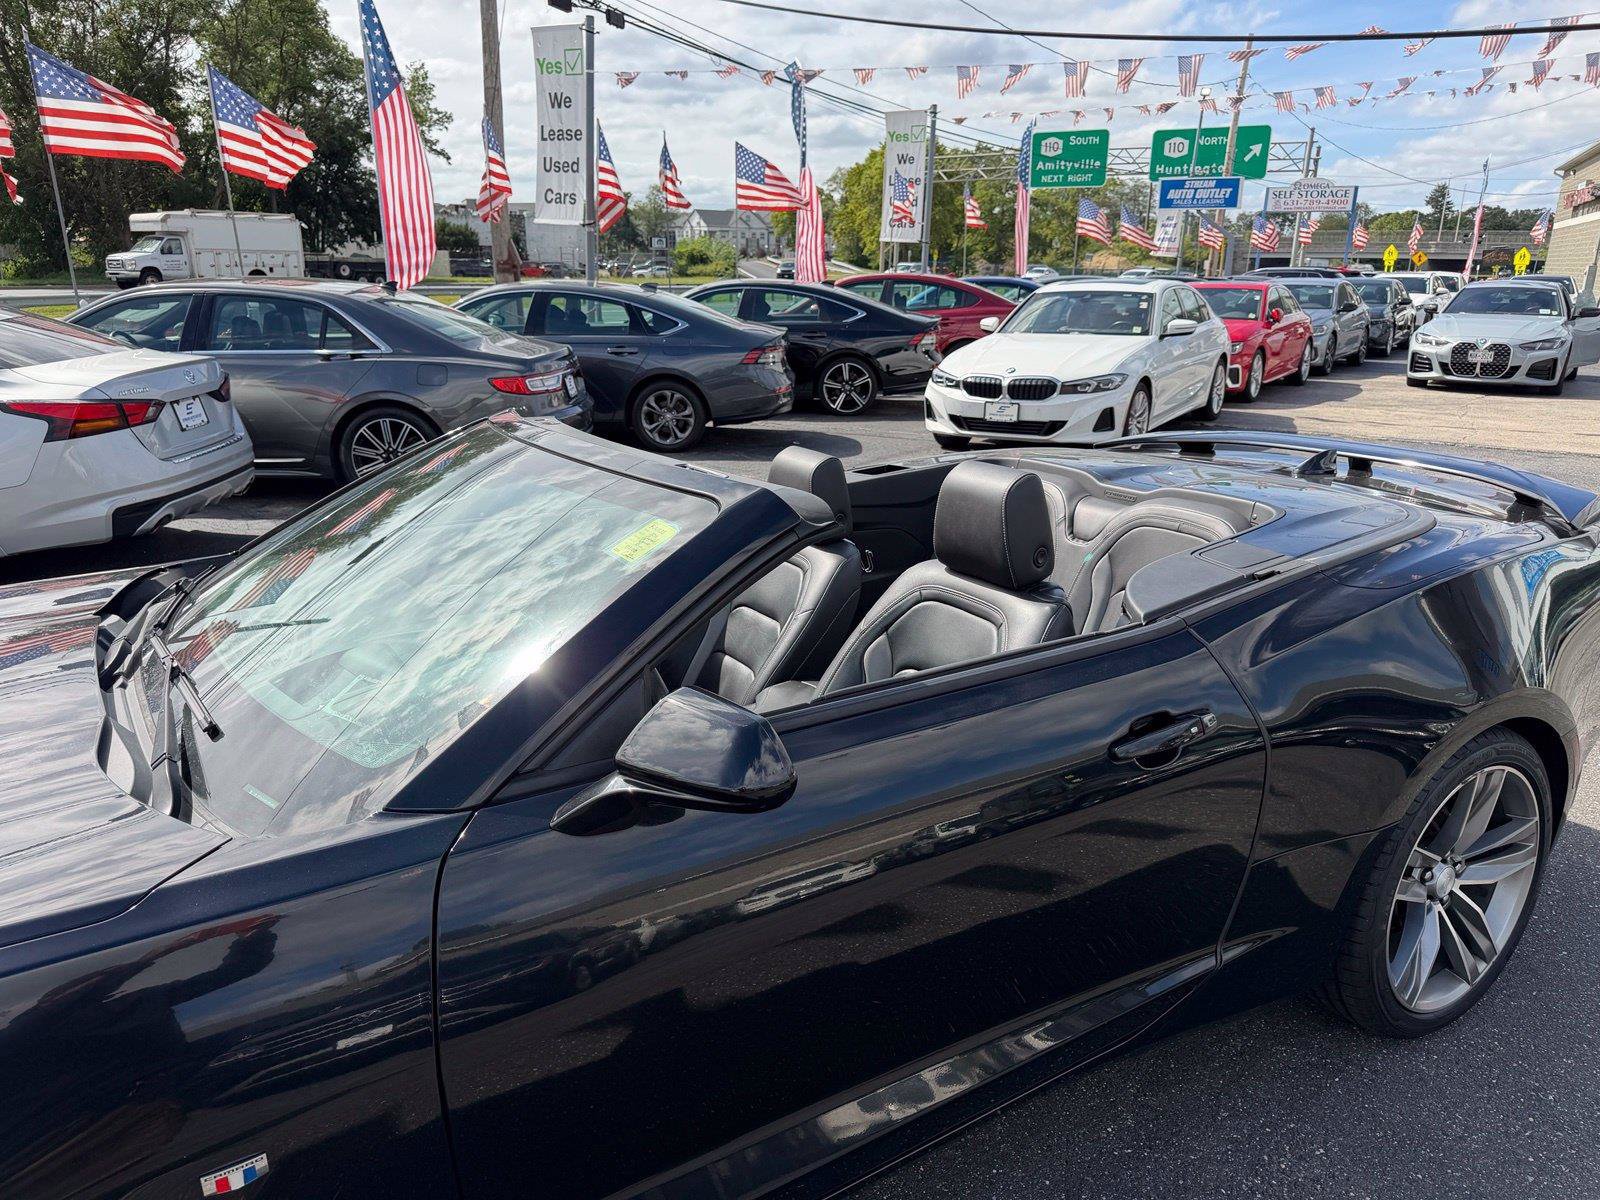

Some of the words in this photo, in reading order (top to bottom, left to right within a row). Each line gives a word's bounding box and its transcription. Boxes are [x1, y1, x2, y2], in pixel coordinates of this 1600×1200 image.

[536, 58, 563, 75] Yes
[548, 92, 573, 109] We
[540, 125, 583, 142] Lease
[888, 130, 910, 142] Yes
[1044, 142, 1060, 152] 110
[1069, 136, 1100, 145] SOUTH
[1168, 142, 1185, 153] 110
[543, 156, 580, 173] Used
[897, 153, 915, 164] We
[1036, 159, 1101, 171] Amityville
[1041, 175, 1064, 183] NEXT
[1068, 174, 1093, 182] RIGHT
[1184, 180, 1216, 188] STREAM
[544, 188, 577, 205] Cars
[1167, 189, 1194, 199] AUTO
[1195, 188, 1233, 198] OUTLET
[1272, 190, 1295, 199] SELF
[1297, 189, 1351, 199] STORAGE
